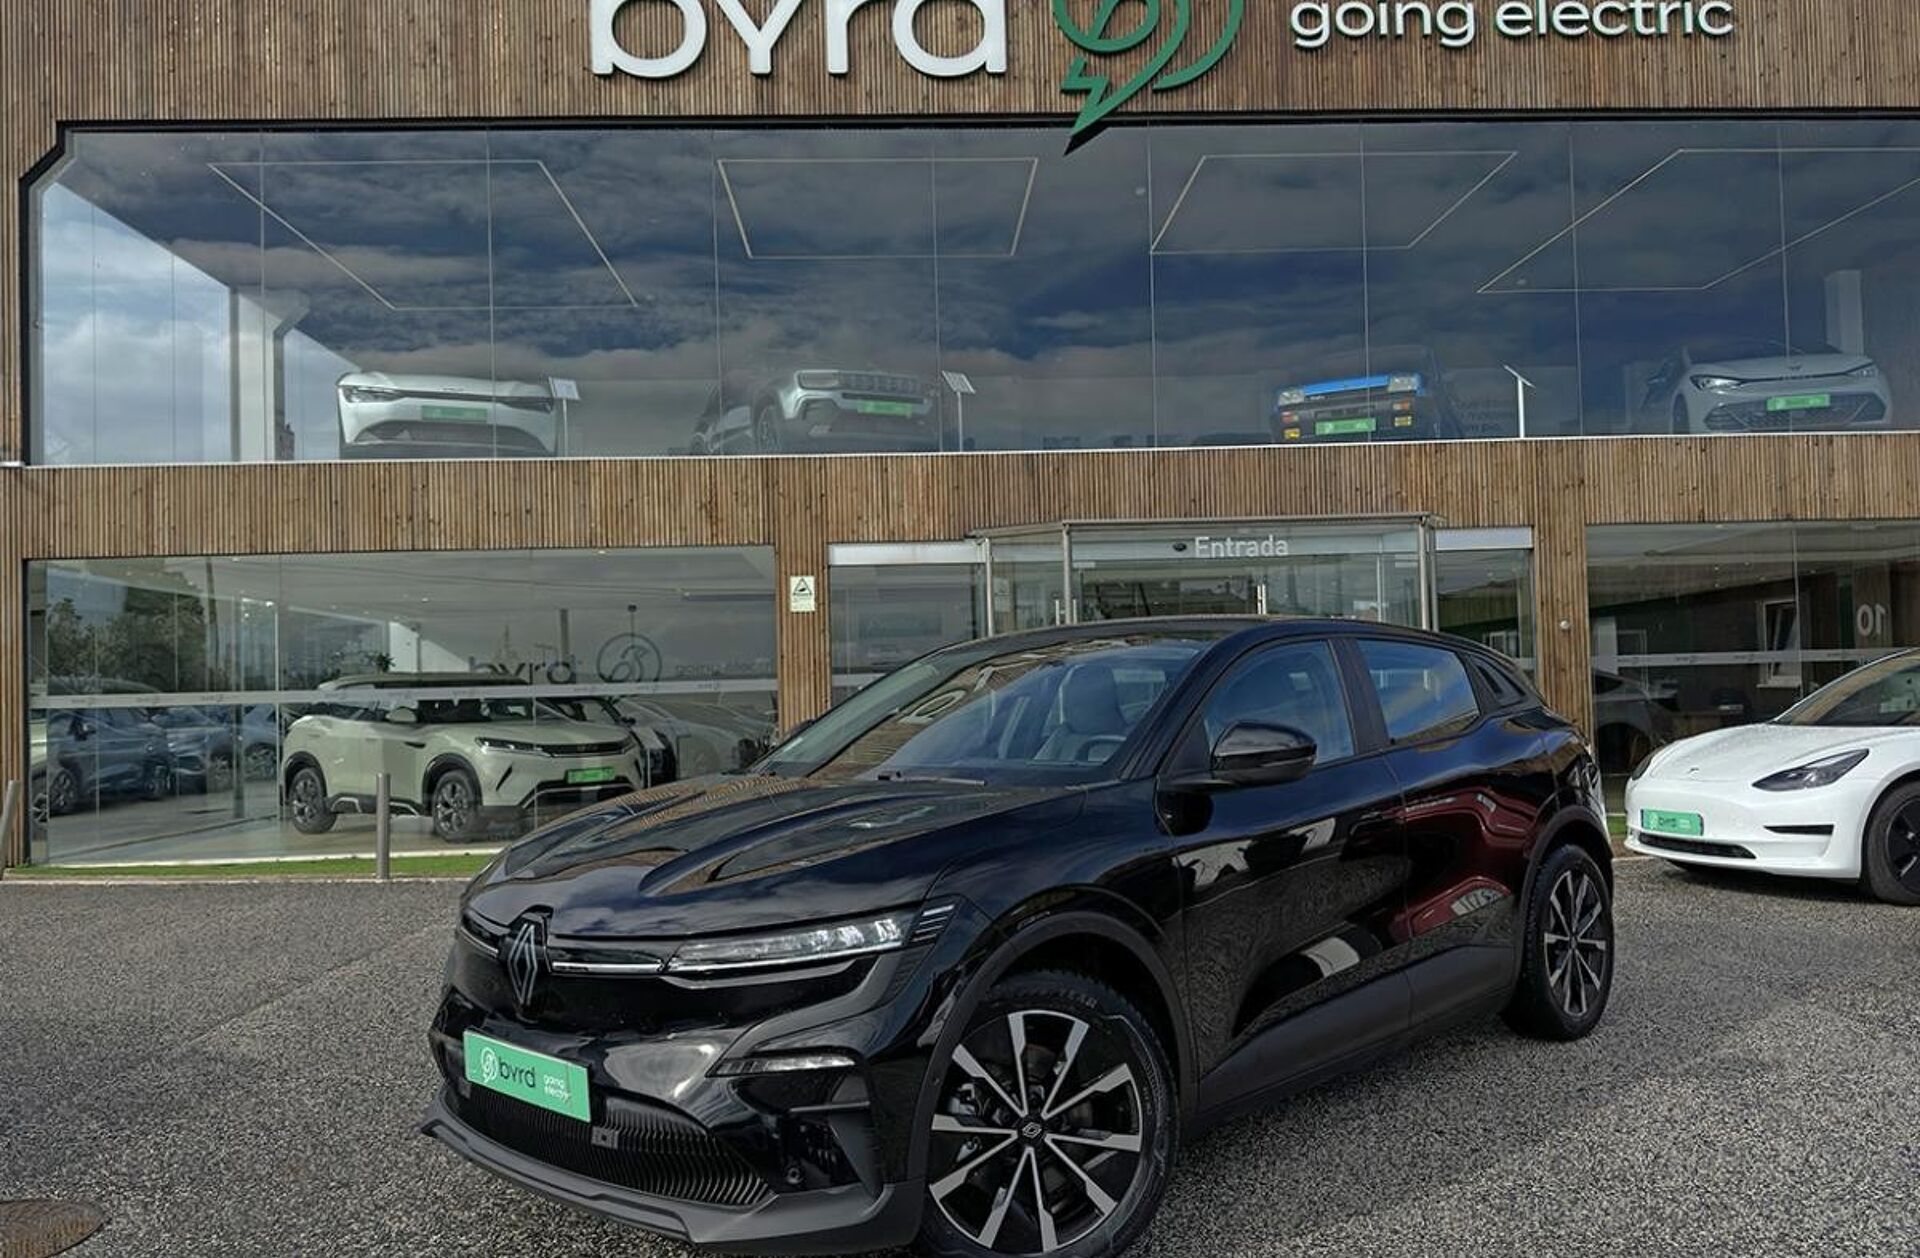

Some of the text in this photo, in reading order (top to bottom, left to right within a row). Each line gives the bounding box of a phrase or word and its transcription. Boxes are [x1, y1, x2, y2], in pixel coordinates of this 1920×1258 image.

[1290, 0, 1735, 48] going electric
[1194, 534, 1289, 559] Entrada
[498, 1057, 536, 1088] byrd
